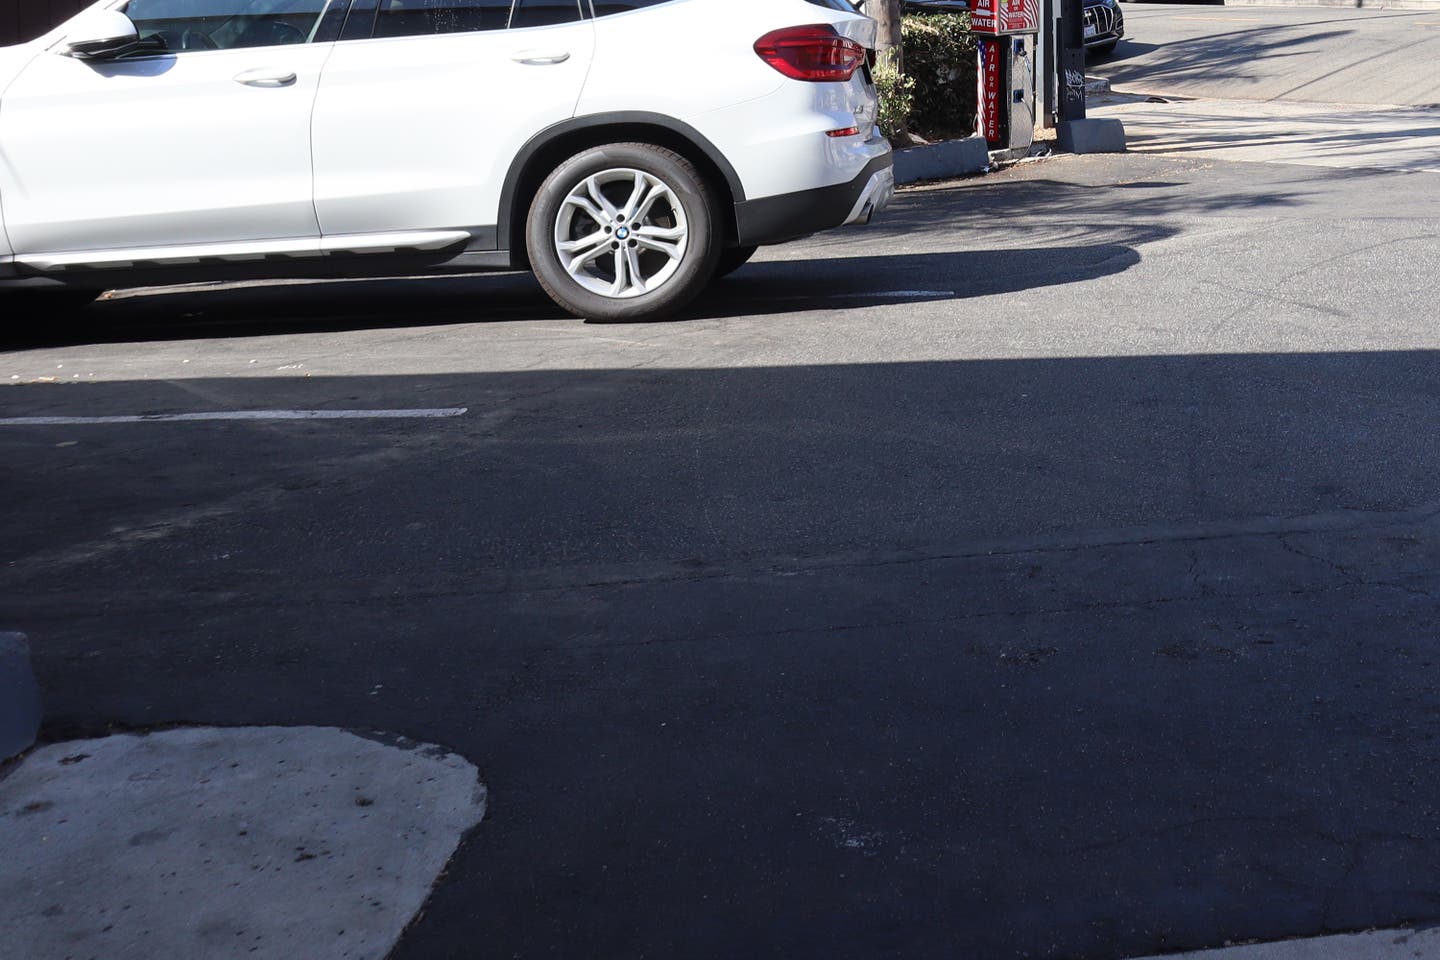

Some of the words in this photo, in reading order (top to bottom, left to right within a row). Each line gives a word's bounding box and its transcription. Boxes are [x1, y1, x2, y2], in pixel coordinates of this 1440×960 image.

[977, 0, 990, 8] AIR
[971, 18, 996, 28] WATER
[988, 44, 996, 72] AIR
[988, 92, 997, 138] WATER
